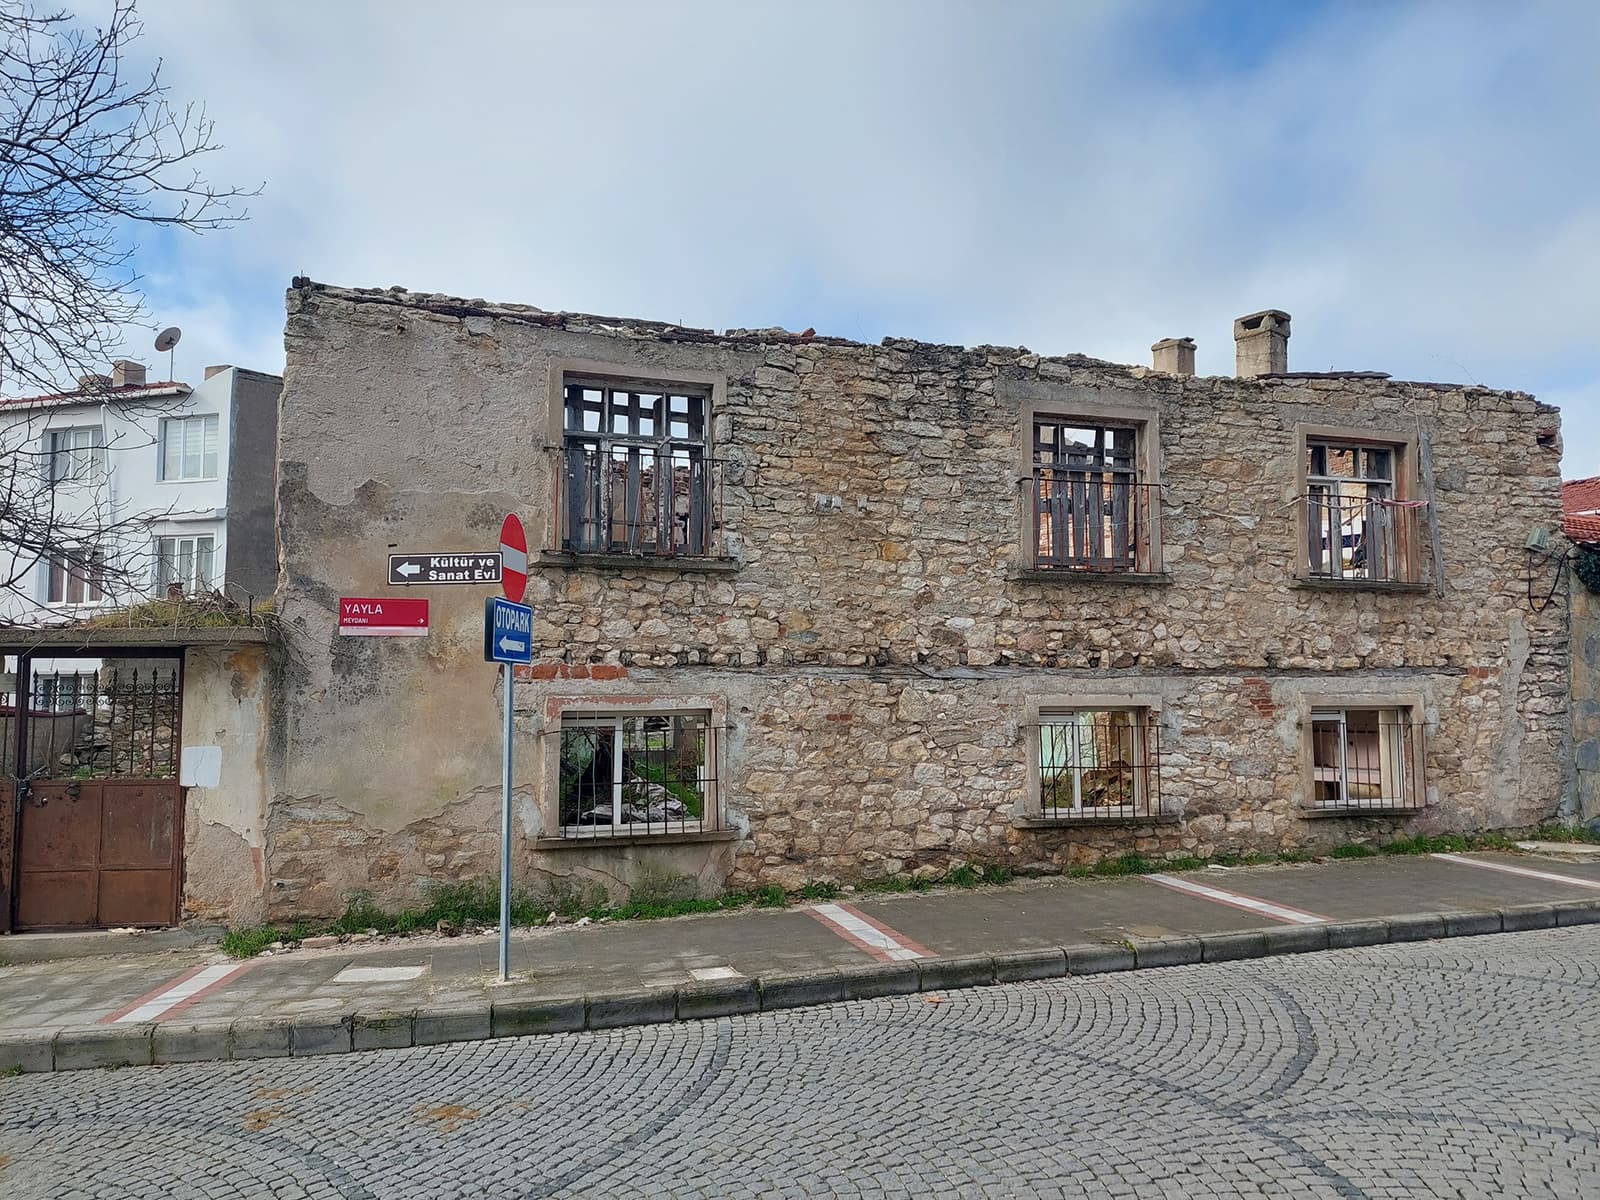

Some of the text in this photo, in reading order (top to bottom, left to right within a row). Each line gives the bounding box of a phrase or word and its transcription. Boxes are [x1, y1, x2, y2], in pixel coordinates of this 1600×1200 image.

[430, 557, 475, 568] Kültür
[429, 569, 496, 581] Sanat Evi
[344, 604, 383, 615] YAYLA
[496, 605, 530, 634] OTOPARK
